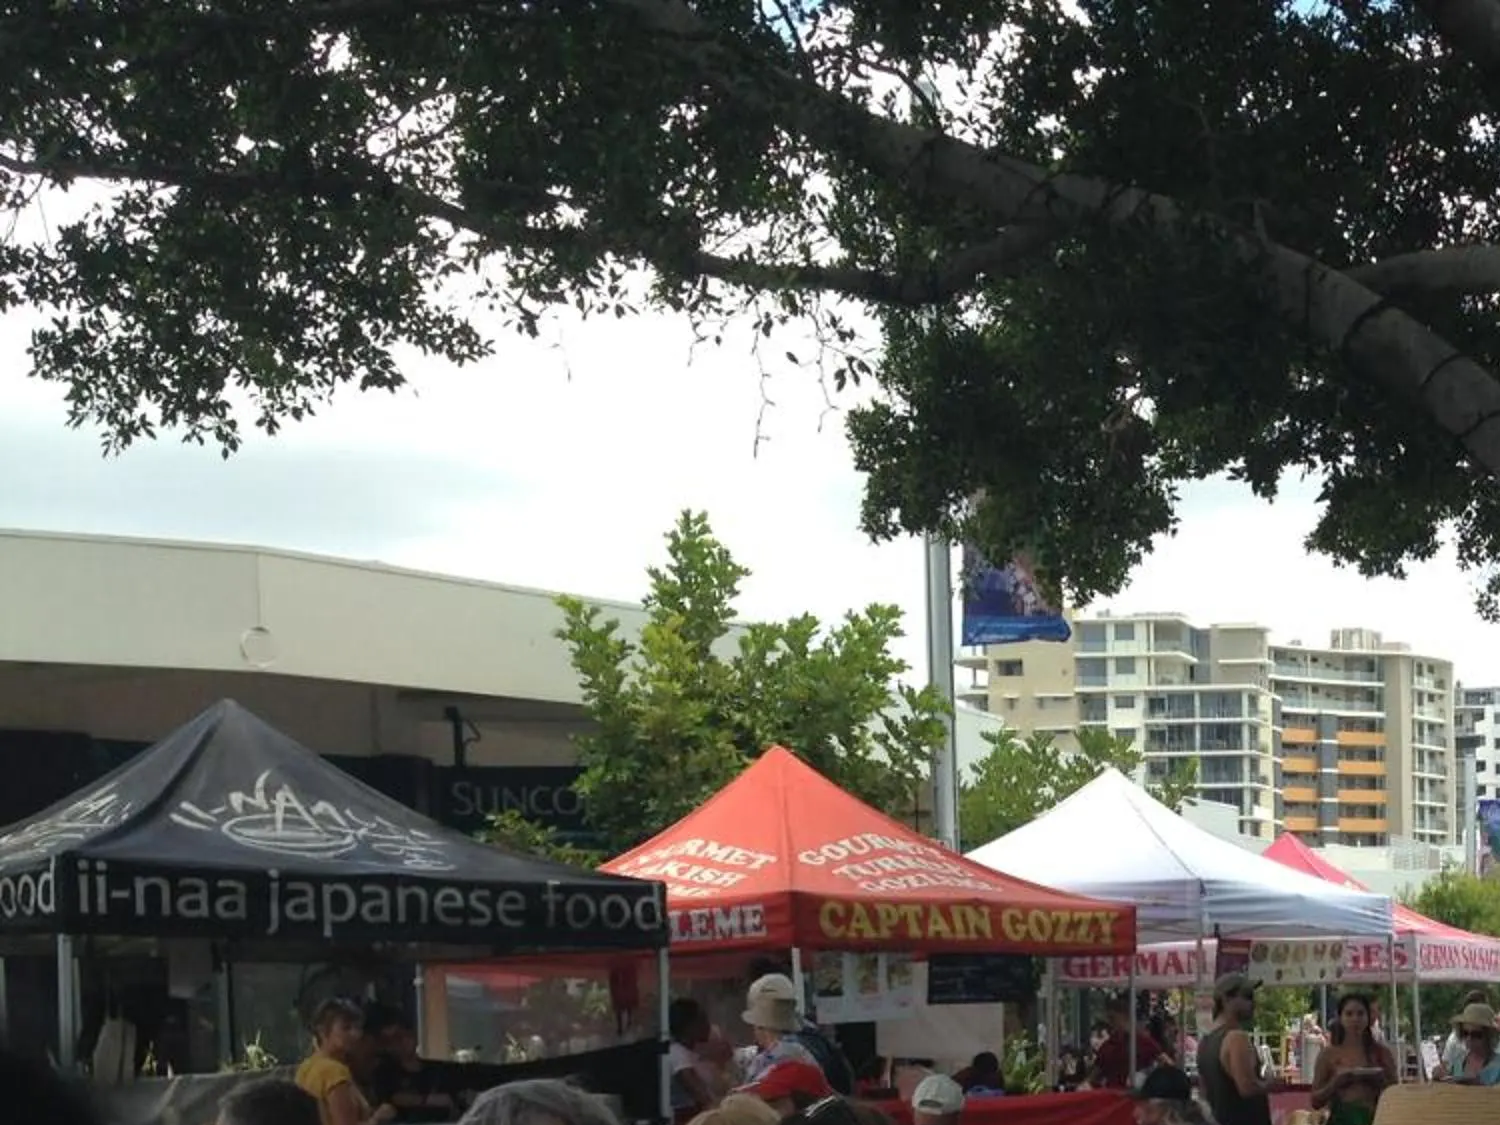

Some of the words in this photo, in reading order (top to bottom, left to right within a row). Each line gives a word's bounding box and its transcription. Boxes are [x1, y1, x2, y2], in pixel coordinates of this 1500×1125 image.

[452, 780, 592, 818] SUNCO
[0, 854, 56, 919] ood
[76, 858, 248, 920] ii-naa
[265, 867, 526, 938] japanese
[541, 879, 662, 930] food
[668, 903, 768, 942] LEME
[818, 900, 993, 941] CAPTAIN
[1001, 907, 1119, 945] GOZZY
[1062, 949, 1208, 980] GERMAN
